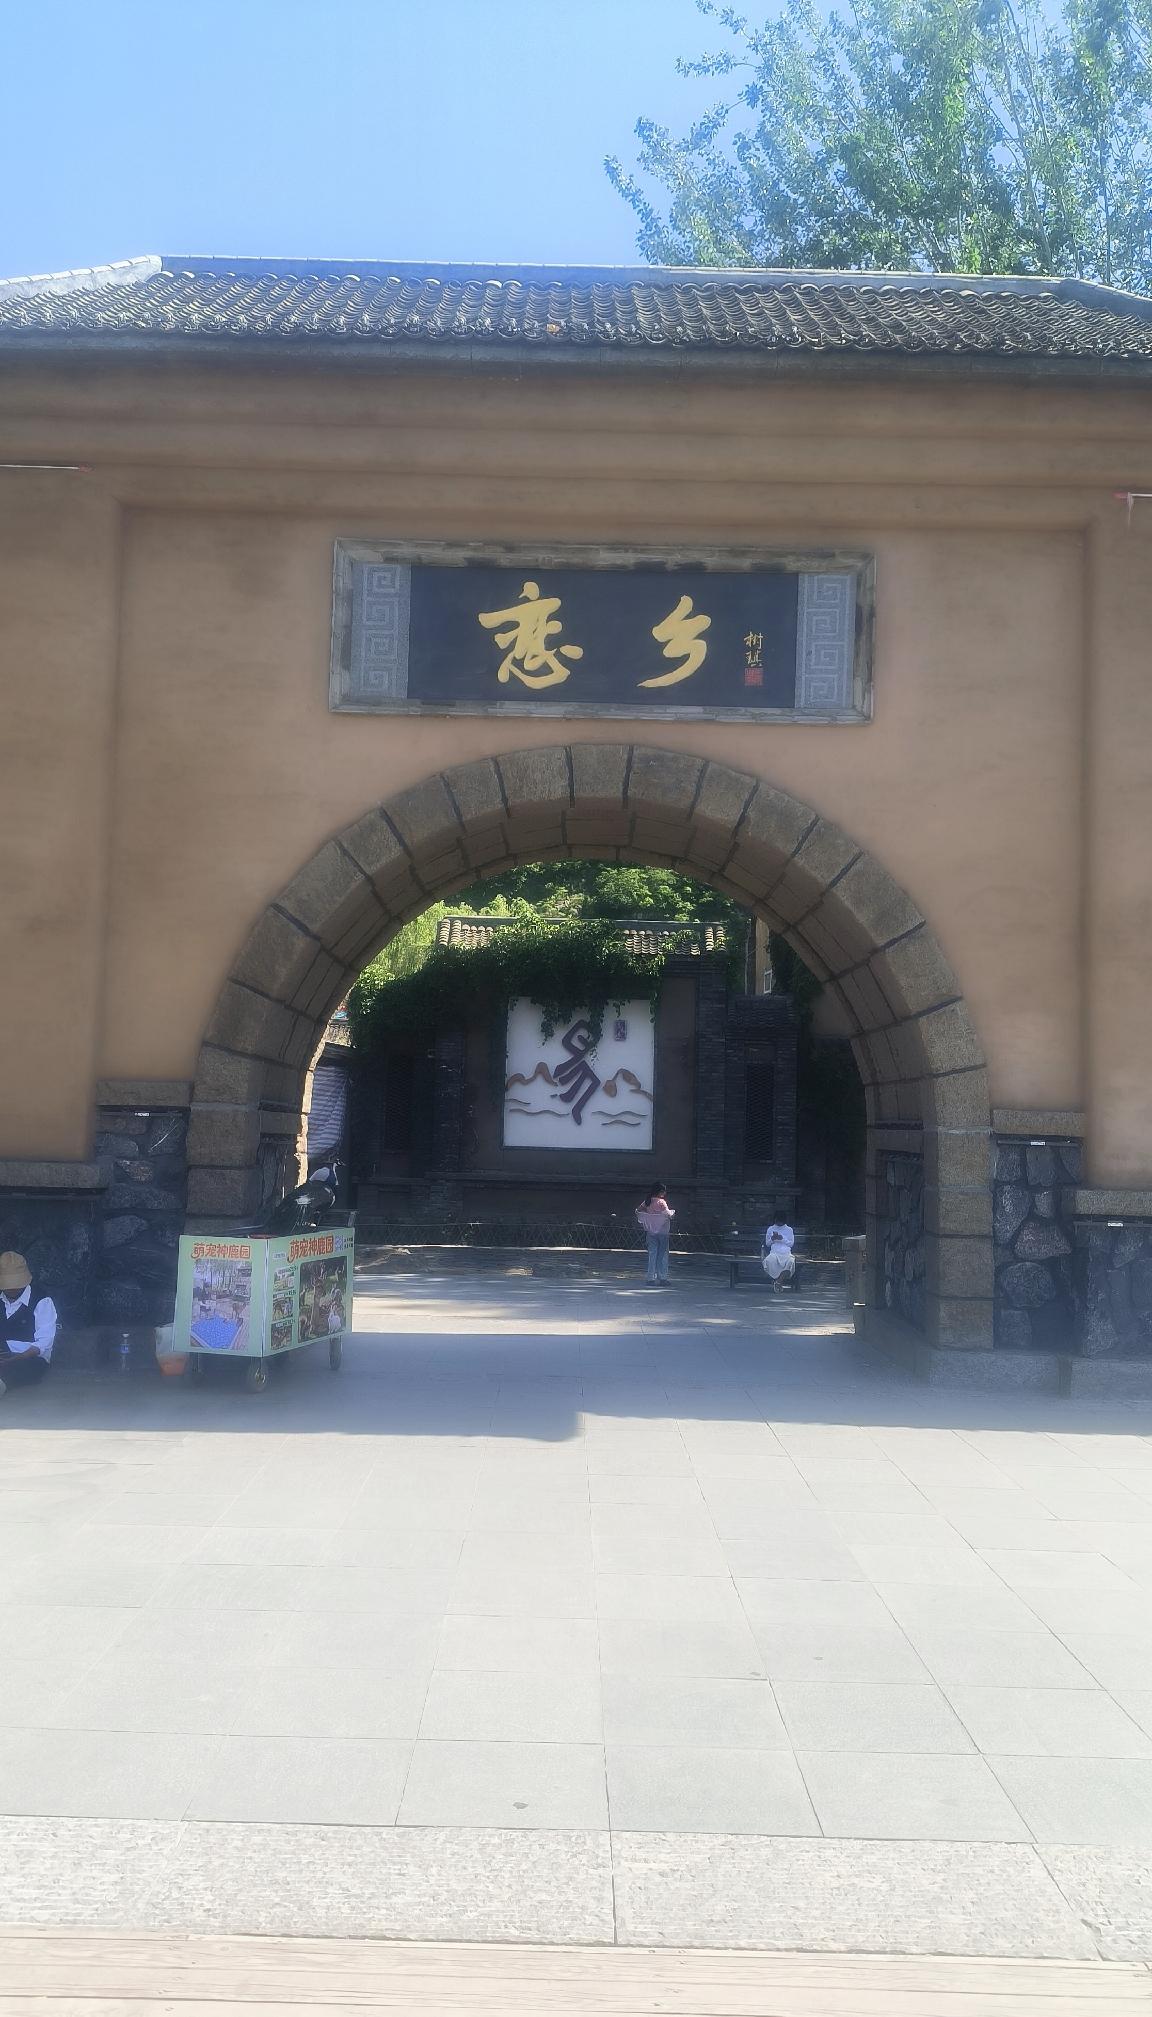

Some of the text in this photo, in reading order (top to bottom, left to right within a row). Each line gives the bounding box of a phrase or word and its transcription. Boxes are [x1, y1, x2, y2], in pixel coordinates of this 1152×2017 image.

[191, 1242, 251, 1260] 萌宠神鹿园
[287, 1234, 334, 1263] 萌宠神鹿园
